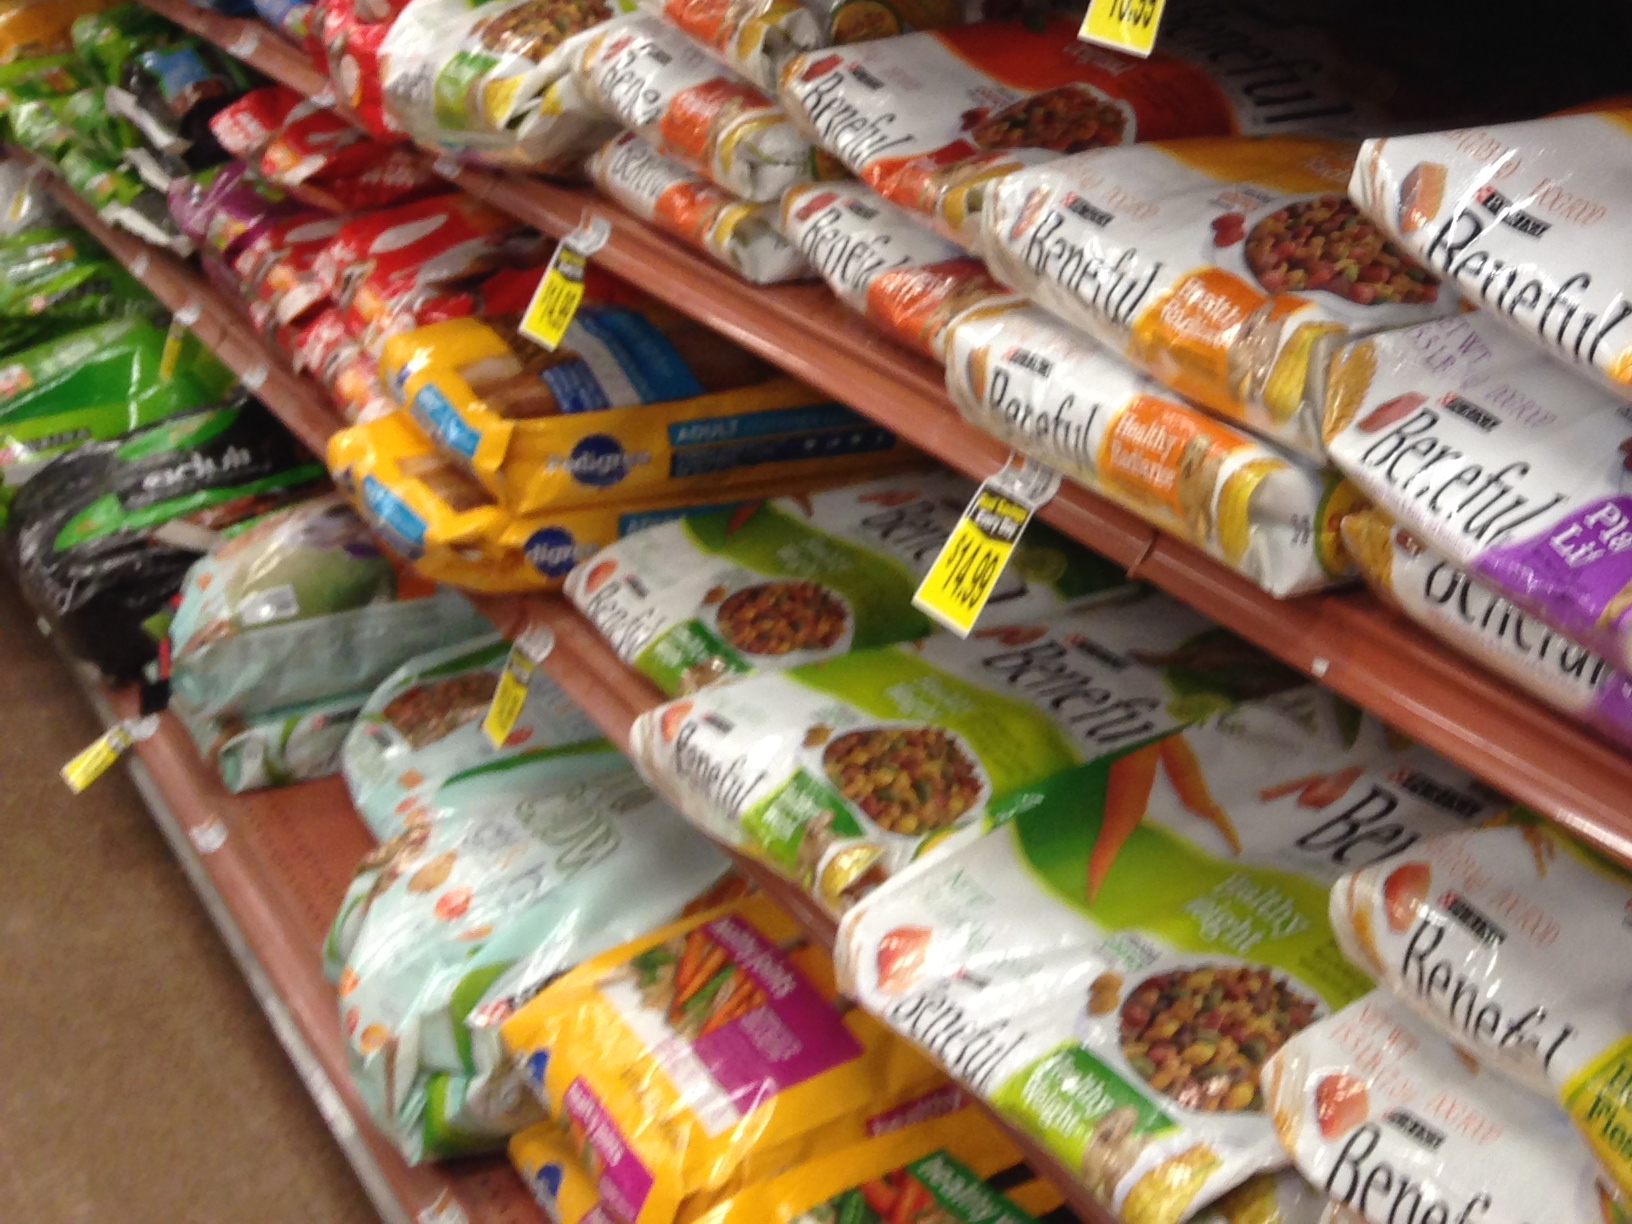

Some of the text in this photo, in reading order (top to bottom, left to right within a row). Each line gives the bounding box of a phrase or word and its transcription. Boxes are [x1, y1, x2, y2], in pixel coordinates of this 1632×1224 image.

[1025, 211, 1162, 325] Beneful
[1114, 410, 1178, 463] Healthy
[1360, 408, 1566, 548] Beneful
[942, 534, 1000, 611] $14.99
[982, 639, 1160, 744] Benefu
[1325, 1123, 1492, 1224] Benef
